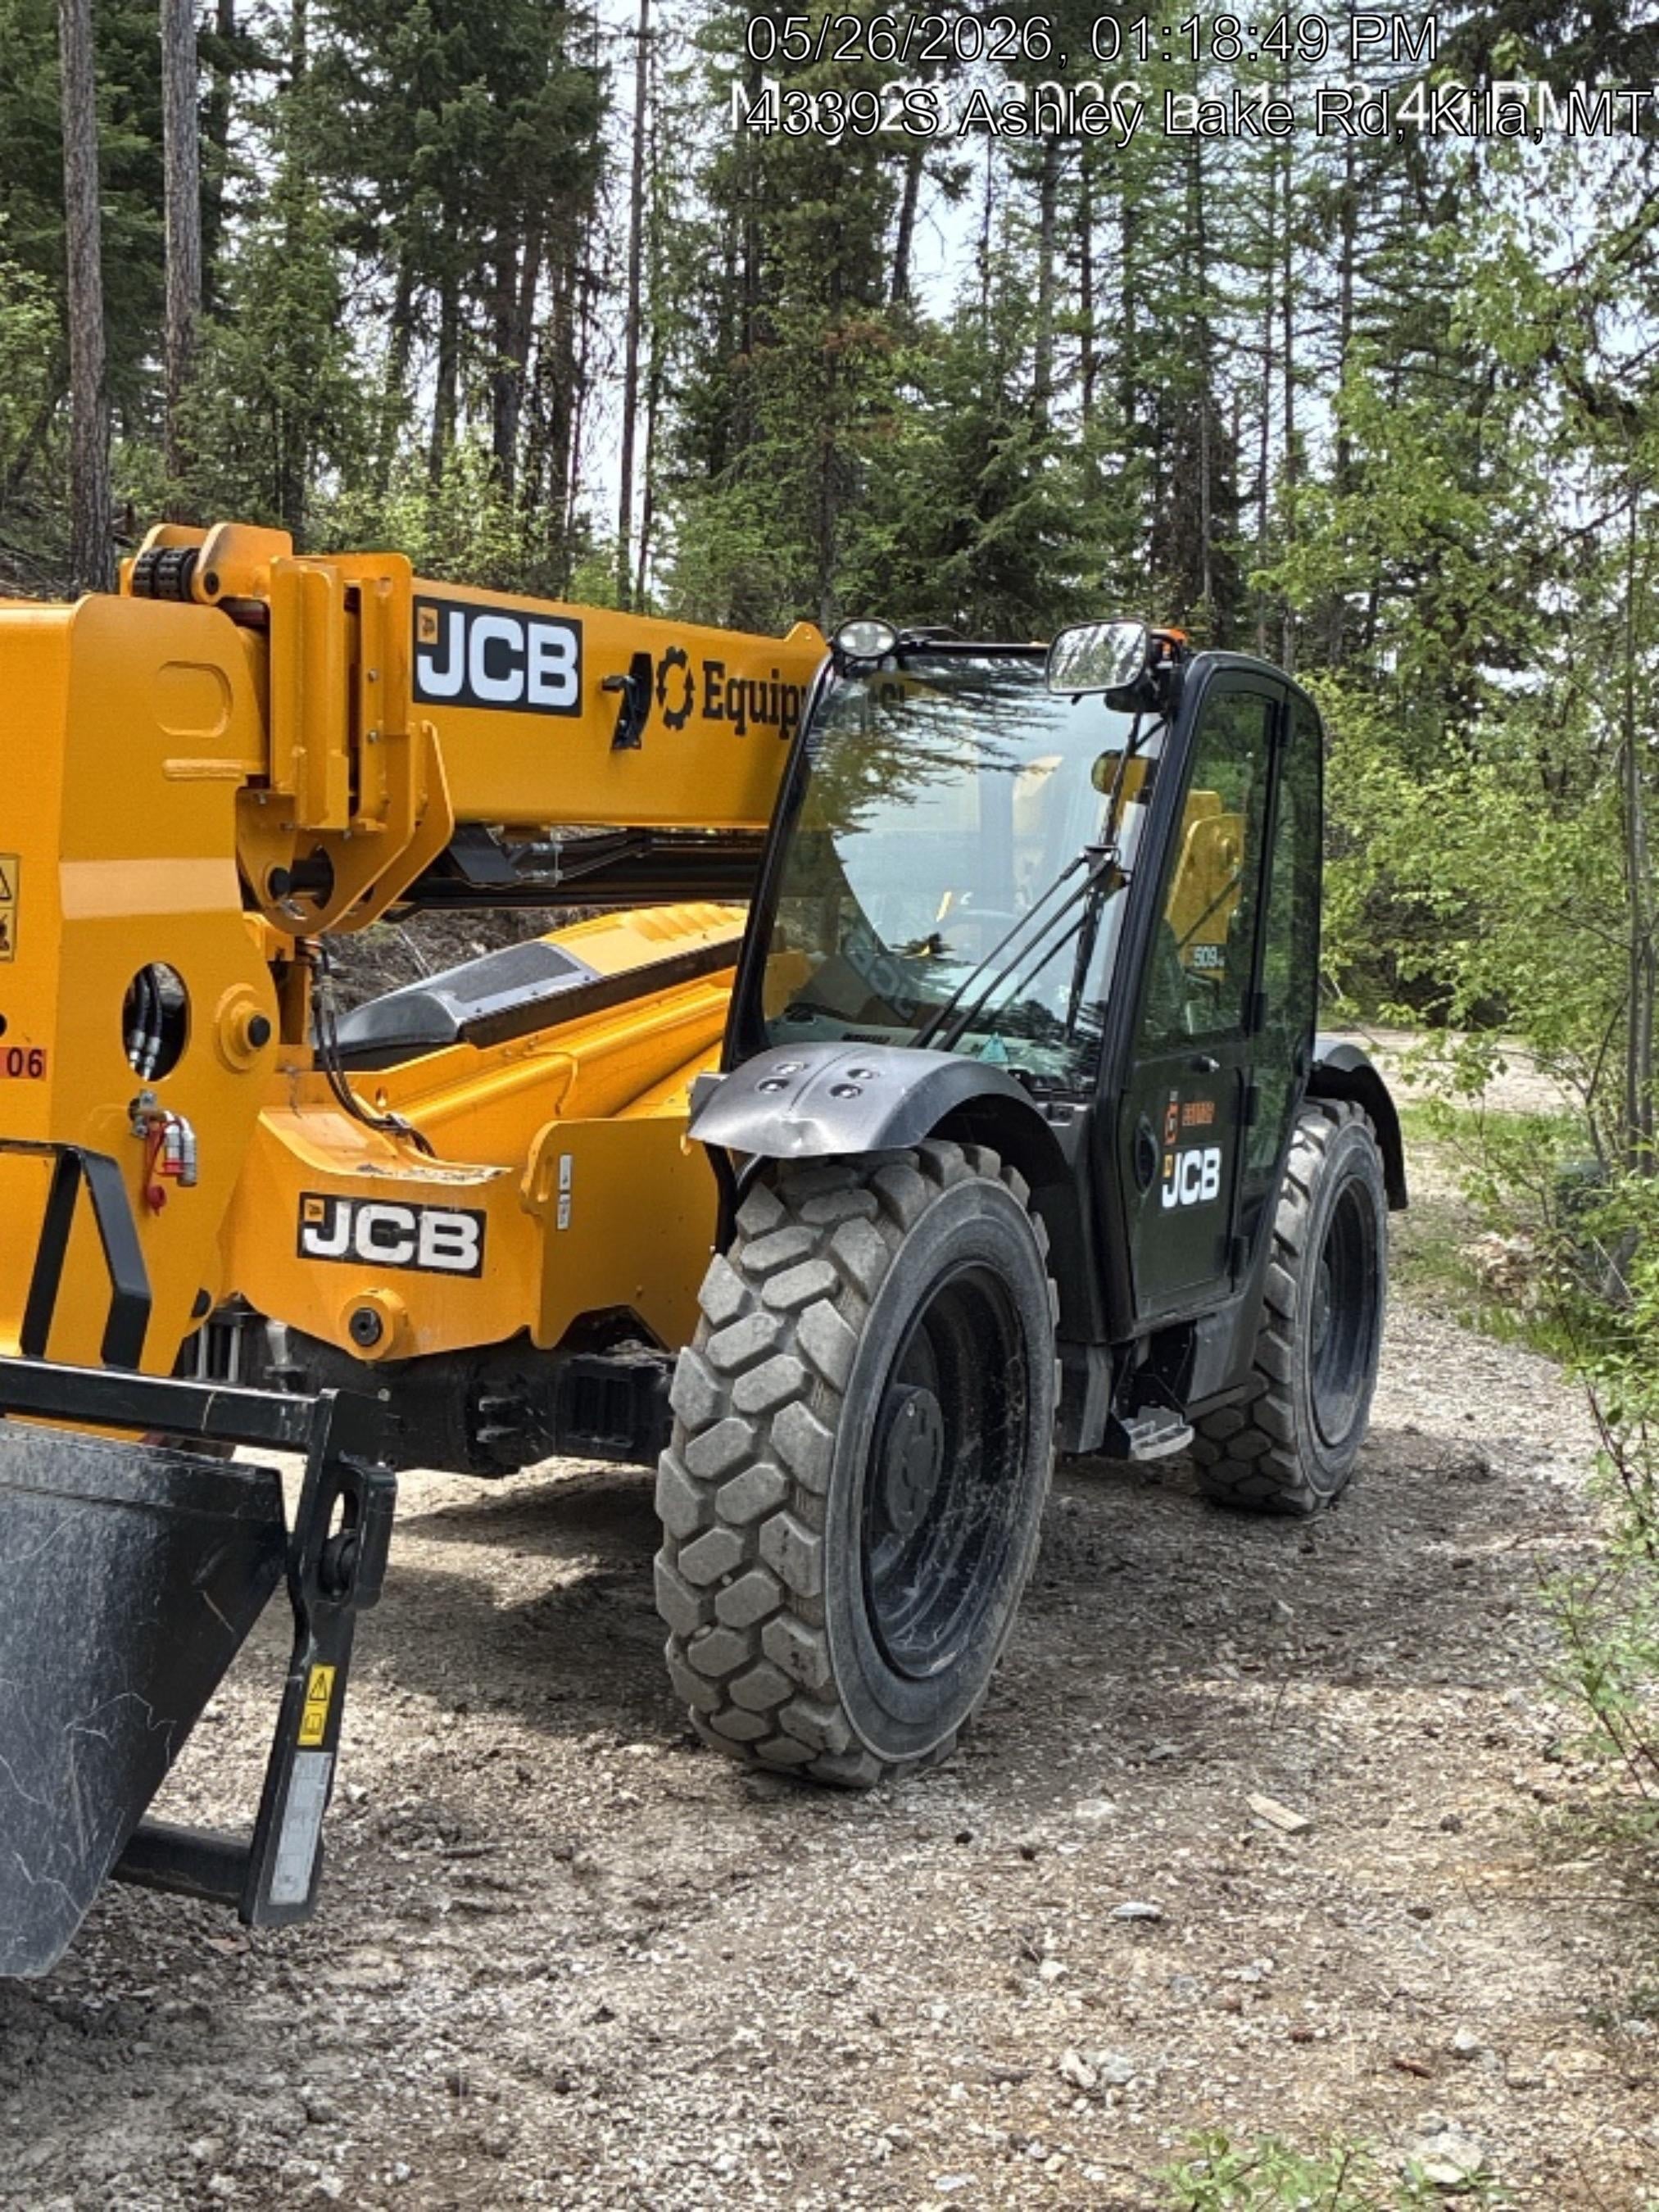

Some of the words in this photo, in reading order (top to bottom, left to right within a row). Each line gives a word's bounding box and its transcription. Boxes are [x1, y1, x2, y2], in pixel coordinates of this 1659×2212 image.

[417, 611, 578, 707] JCB
[702, 660, 806, 740] Equip
[1162, 1147, 1221, 1208] JCB
[303, 1201, 479, 1271] JCB
